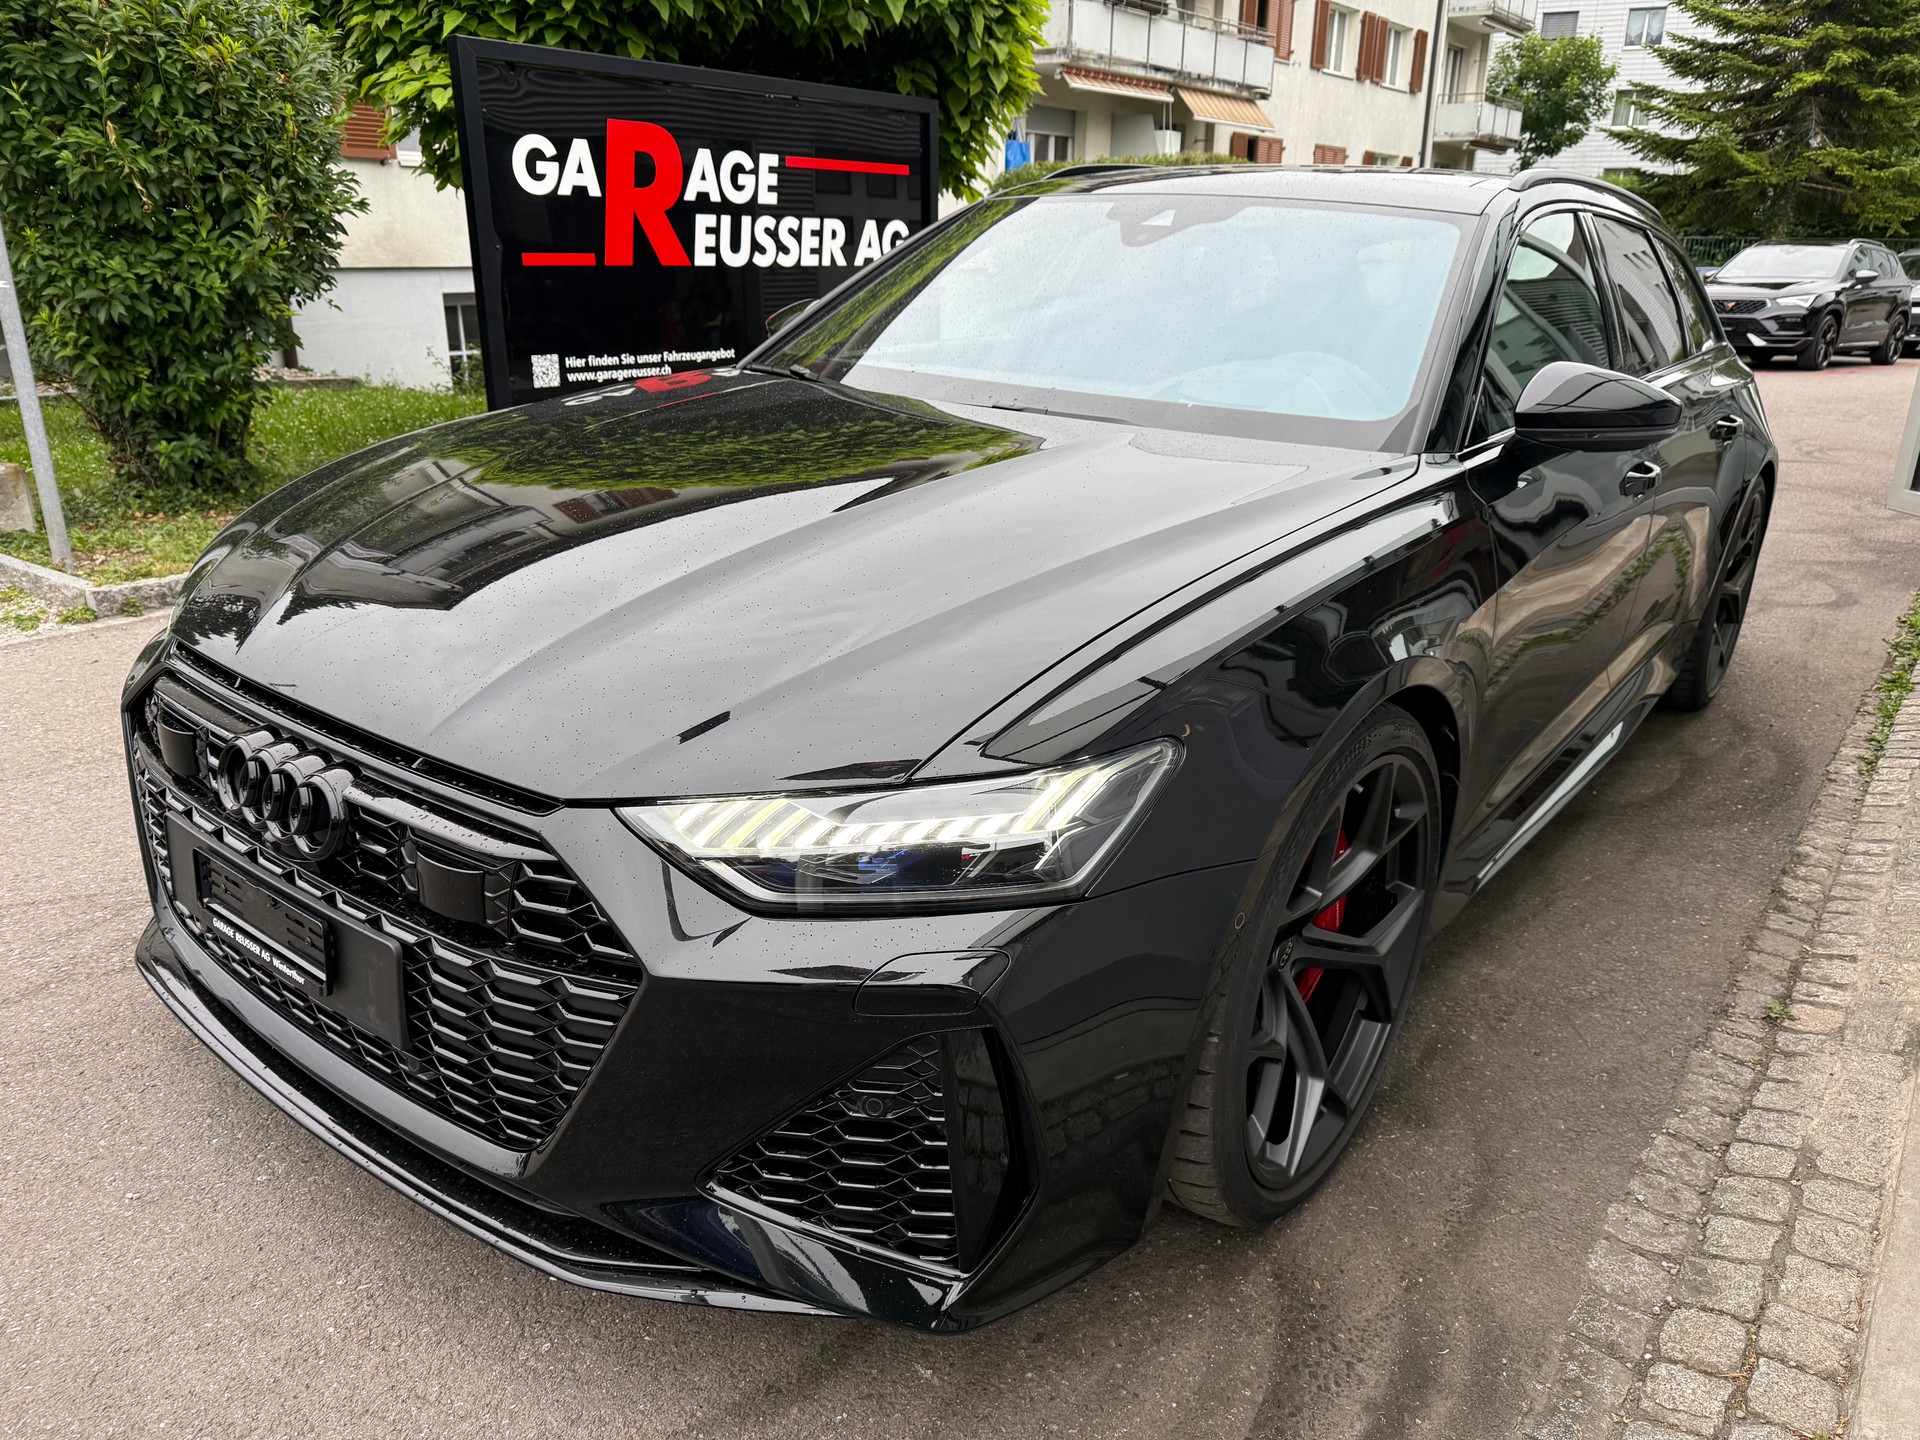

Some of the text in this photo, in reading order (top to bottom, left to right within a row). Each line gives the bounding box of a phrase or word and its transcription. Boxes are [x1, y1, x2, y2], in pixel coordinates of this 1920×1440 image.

[512, 118, 779, 266] GARAGE
[854, 219, 910, 266] AG
[565, 349, 735, 368] Hier finden Sie unser Fahrzeugangebot
[567, 365, 671, 382] www.garagereusser.ch
[212, 917, 305, 985] GARAGE REUSSER AG Winterthur
